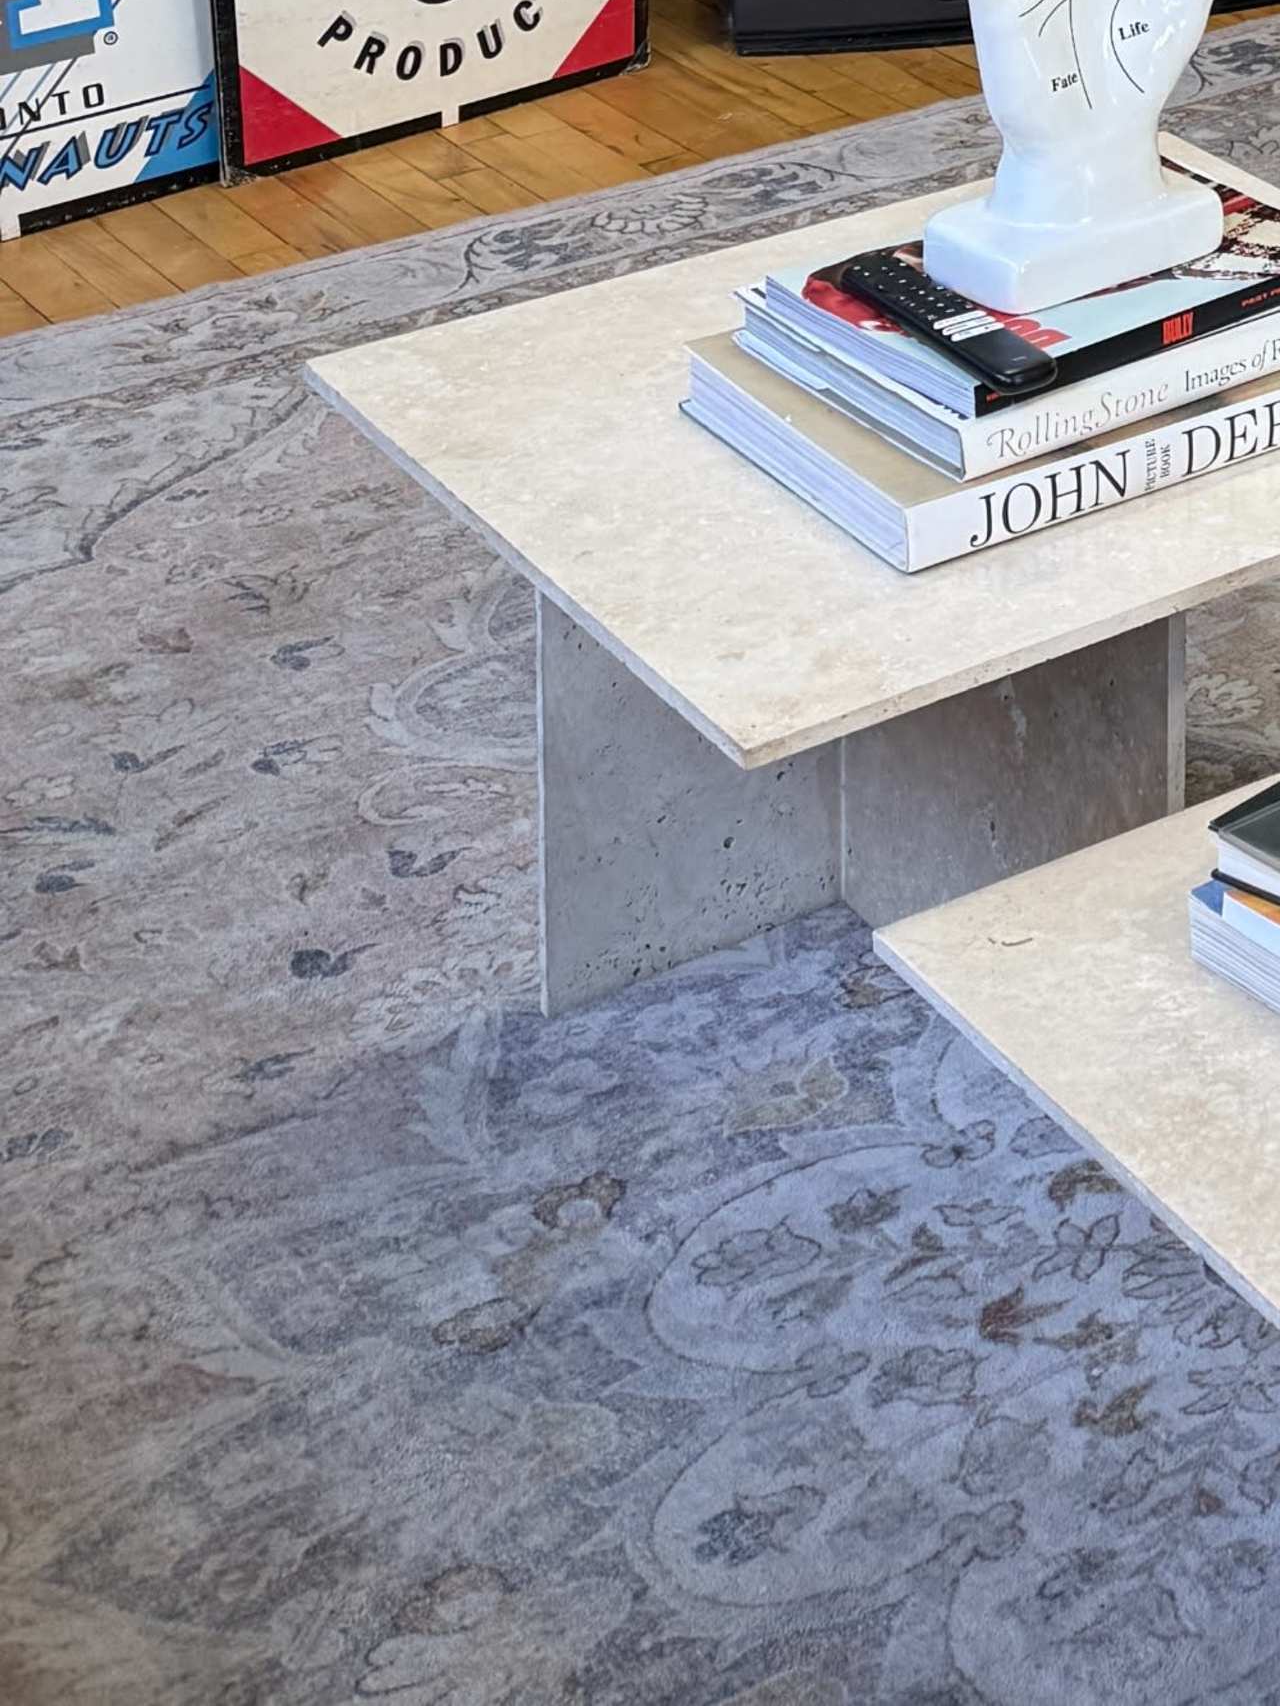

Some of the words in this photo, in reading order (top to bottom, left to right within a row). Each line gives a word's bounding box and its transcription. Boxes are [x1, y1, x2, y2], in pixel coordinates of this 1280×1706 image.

[1118, 21, 1150, 40] Life
[1051, 72, 1079, 92] Fate
[0, 83, 105, 131] NTO
[1184, 361, 1248, 392] Images
[1251, 339, 1271, 371] of
[1144, 439, 1157, 491] PICTURE
[1160, 444, 1170, 478] BOOK
[968, 450, 1132, 551] JOHN
